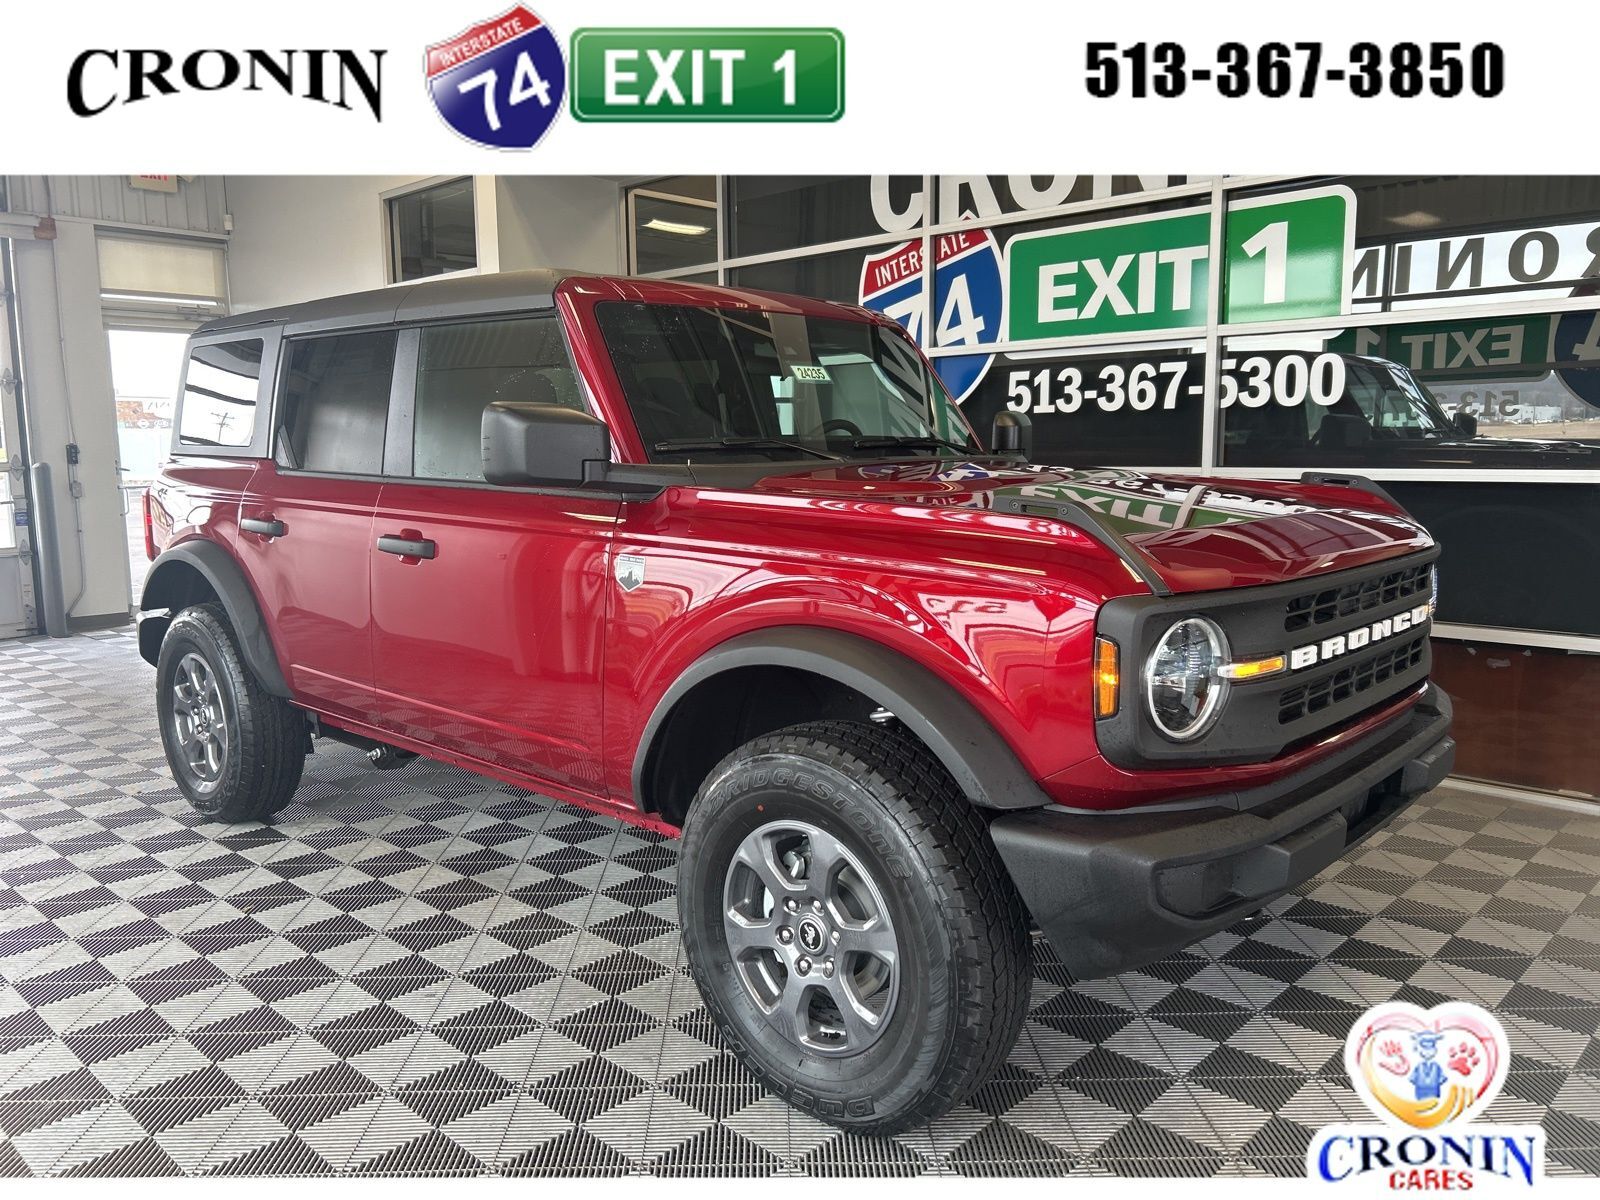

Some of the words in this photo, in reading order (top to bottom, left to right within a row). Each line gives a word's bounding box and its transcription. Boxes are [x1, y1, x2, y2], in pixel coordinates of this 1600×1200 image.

[875, 232, 970, 288] INTERATE
[1038, 245, 1209, 324] EXIT
[1241, 221, 1288, 304] 1
[797, 367, 826, 380] 24235
[1006, 352, 1346, 414] 513-367-5300
[1290, 604, 1428, 670] BRONCO
